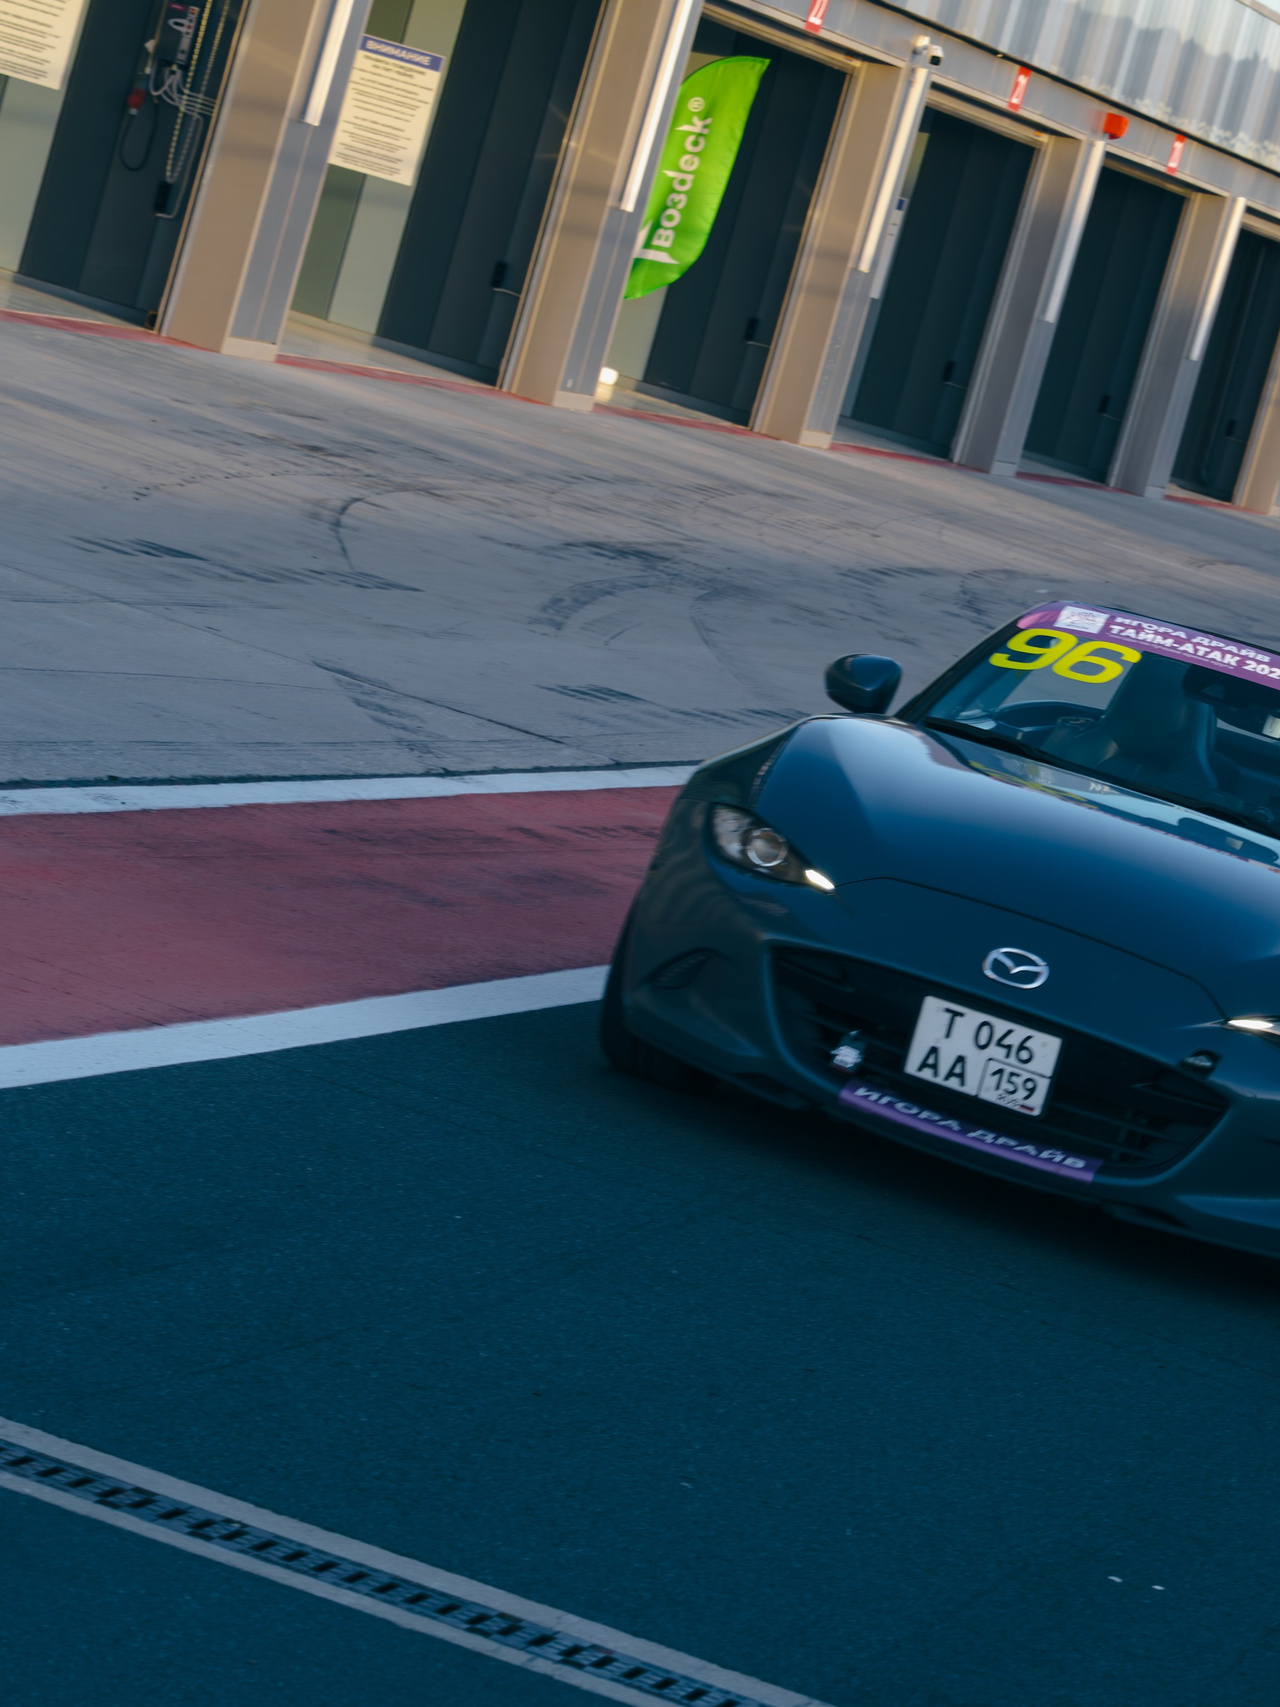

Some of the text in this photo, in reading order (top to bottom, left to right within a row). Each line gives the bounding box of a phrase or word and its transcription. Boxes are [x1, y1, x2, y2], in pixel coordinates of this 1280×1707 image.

[365, 40, 432, 66] ВНИМАНИЕ
[988, 628, 1142, 684] 96
[1109, 625, 1240, 667] ТАЙМ-АТАК
[1113, 616, 1271, 663] ИГОРА ДРАЙВ
[974, 1020, 1035, 1065] 046
[989, 1067, 1037, 1101] 159
[853, 1086, 1087, 1169] ИГОРА ДРАЙВ
